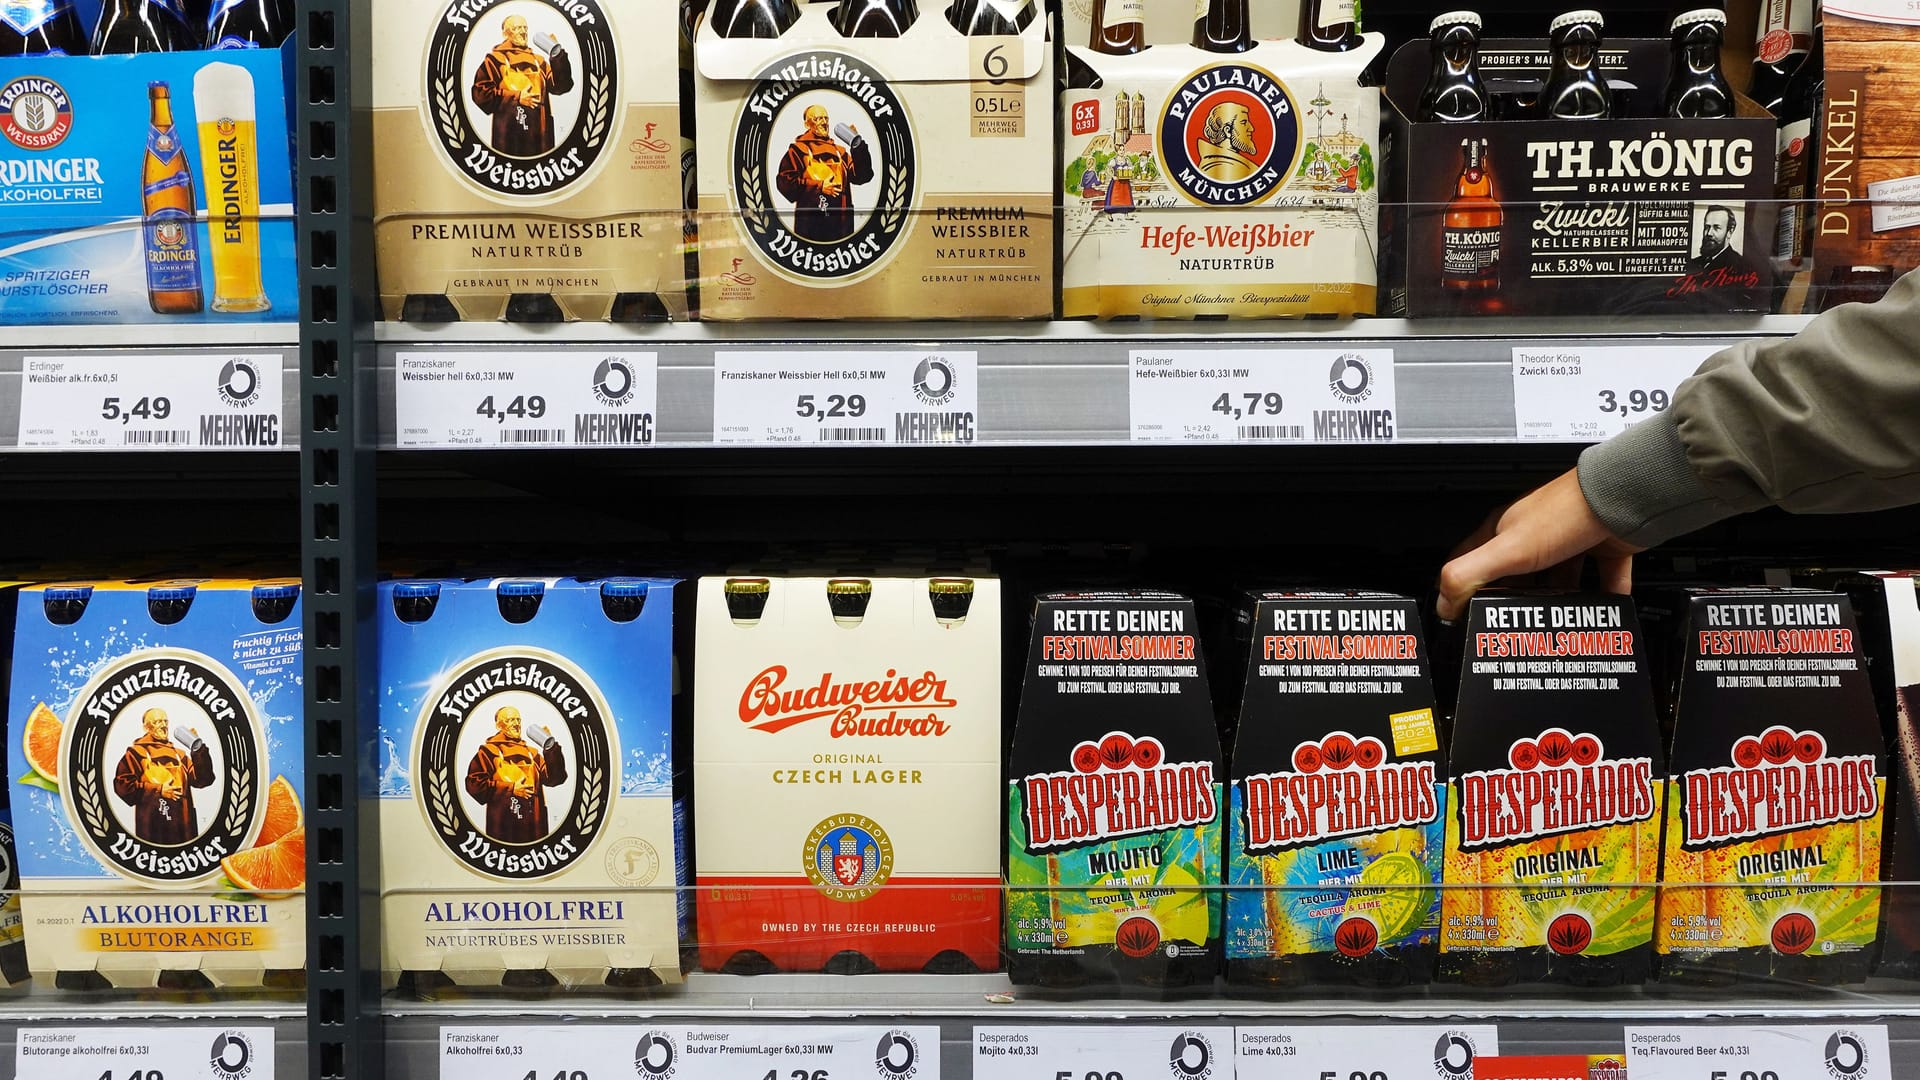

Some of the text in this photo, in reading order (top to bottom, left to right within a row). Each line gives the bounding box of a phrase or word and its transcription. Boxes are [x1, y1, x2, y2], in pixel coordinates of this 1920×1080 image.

[983, 45, 1008, 77] 6
[1, 80, 66, 109] ERDINGER
[750, 56, 893, 122] Franziskaner
[1169, 69, 1290, 121] PAULANER
[7, 121, 67, 146] WEISSBRÄU
[1527, 131, 1752, 178] TH.KÖNIG
[1821, 89, 1858, 237] DUNKEL
[0, 158, 104, 187] RDINGER
[464, 143, 586, 190] Weissbier
[217, 136, 242, 244] ERDINGER
[1178, 167, 1279, 202] MÜNCHEN
[1589, 182, 1690, 193] BRAUWERKE
[936, 206, 1025, 220] PREMIUM
[1533, 201, 1630, 236] Zwickl
[412, 222, 644, 240] PREMIUM WEISSBIER
[932, 225, 1030, 238] WEISSBIER
[1140, 223, 1315, 255] Hefe-Weißbier
[1532, 236, 1629, 248] KELLERBIER
[1637, 227, 1689, 238] MIT 100%
[472, 244, 582, 258] NATURTRÜB
[768, 228, 880, 273] Weissbier
[936, 247, 1026, 258] NATURTRÜB
[1637, 238, 1689, 247] AROMAHOPFEN
[1180, 258, 1275, 271] NATURTRÜB
[1531, 259, 1615, 274] ALK. 5,3% VOL
[1625, 257, 1687, 265] PROBIER'S MAL
[1625, 264, 1687, 273] UNGEFILTERT.
[6, 270, 90, 281] SPRITZIGER
[454, 277, 599, 288] GEBRAUT IN MÜNCHEN
[1141, 293, 1182, 306] Original
[1184, 293, 1234, 305] Münchner
[30, 362, 64, 372] Erdinger
[402, 359, 456, 369] Franziskaner
[1136, 357, 1173, 366] Paulaner
[1519, 353, 1581, 365] Theodor König
[29, 373, 67, 383] Weißbier
[402, 372, 514, 382] Weissbier hell 6x0,33l MW
[721, 371, 886, 381] Franziskaner Weissbier Hell 6x0,5l MW
[1136, 369, 1249, 379] Hefe-Weißbier 6x0,33l MW
[1519, 366, 1582, 377] Zwickl 6x0,33l
[102, 397, 171, 425] 5,49
[476, 395, 546, 424] 4,49
[796, 394, 866, 422] 5,29
[1212, 392, 1283, 420] 4,79
[1598, 389, 1669, 418] 3,99
[200, 414, 278, 447] MEHRWEG
[574, 413, 652, 446] MEHRWEG
[895, 411, 973, 444] MEHRWEG
[1312, 409, 1393, 442] MEHRWEG
[1053, 610, 1183, 632] RETTE DEINEN
[1274, 609, 1406, 632] RETTE DEINEN
[1485, 606, 1621, 629] RETTE DEINEN
[1707, 604, 1841, 626] RETTE DEINEN
[1043, 635, 1195, 661] FESTIVALSOMMER
[1263, 635, 1417, 660] FESTIVALSOMMER
[1476, 631, 1634, 657] FESTIVALSOMMER
[1699, 629, 1854, 655] FESTIVALSOMMER
[1038, 665, 1064, 677] GEWINNE
[1068, 665, 1080, 677] VON
[1080, 665, 1091, 676] 100
[1091, 665, 1115, 677] PREISEN
[1115, 663, 1127, 677] FÜR
[1127, 665, 1148, 677] DEINEN
[87, 664, 236, 725] Franziskaner
[440, 662, 589, 723] Franziskaner
[738, 664, 957, 728] Budweiser
[830, 703, 951, 738] Budvar
[813, 753, 883, 765] ORIGINAL
[772, 770, 923, 784] CZECH LAGER
[1026, 764, 1216, 845] DESPERADOS
[1247, 764, 1436, 846] DESPERADOS
[1462, 761, 1653, 843] DESPERADOS
[1687, 757, 1875, 842] DESPERADOS
[110, 832, 228, 875] Weissbier
[459, 831, 578, 873] Weissbier
[805, 817, 890, 871] ČESKÉ BUDĚJOVICE
[1088, 845, 1163, 875] MOJITO
[1317, 847, 1360, 873] LIME
[1513, 846, 1604, 880] ORIGINAL
[1737, 844, 1828, 878] ORIGINAL
[1090, 887, 1176, 905] TEQUILA AROMA
[81, 904, 268, 924] ALKOHOLFREI
[425, 900, 624, 922] ALKOHOLFREI
[1309, 904, 1346, 917] CACTUS
[1357, 900, 1381, 910] LIME
[762, 923, 936, 932] OWNED BY THE CZECH REPUBLIC
[100, 931, 254, 947] BLUTORANGE
[426, 933, 626, 947] NATURTRÜBES WEISSBIER
[23, 1033, 76, 1043] Franziskaner
[446, 1033, 499, 1043] Franziskaner
[687, 1032, 729, 1041] Budweiser
[980, 1033, 1028, 1044] Desperados
[1242, 1033, 1291, 1044] Desperados
[1632, 1033, 1681, 1043] Desperados
[23, 1046, 149, 1056] Blutorange alkoholfrei 6x0,33l
[446, 1046, 523, 1056] Alkoholfrei 6x0,33
[687, 1045, 833, 1056] Budvar PremiumLager 6x0,33l MW
[980, 1046, 1038, 1056] Mojito 4x0,33l
[1242, 1046, 1296, 1056] Lime 4x0,33l
[1632, 1046, 1749, 1056] Teq.Flavoured Beer 4x0,33l
